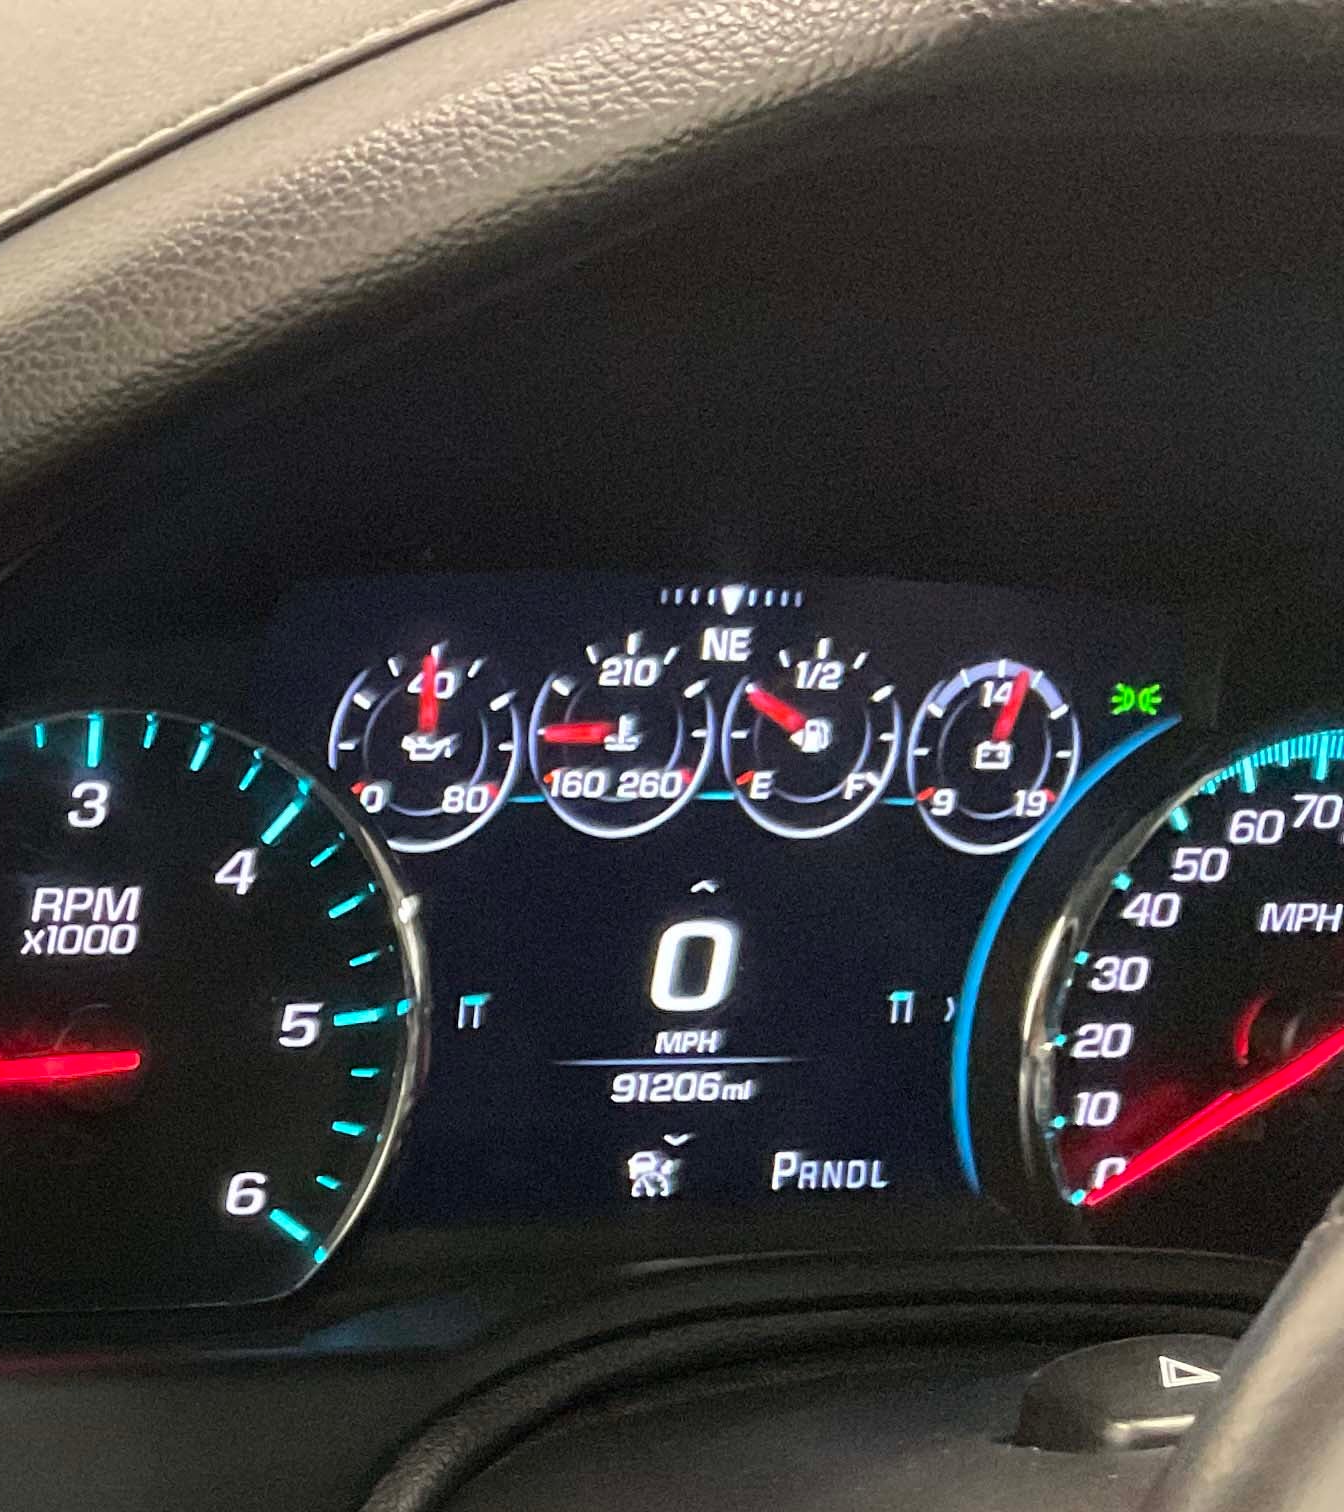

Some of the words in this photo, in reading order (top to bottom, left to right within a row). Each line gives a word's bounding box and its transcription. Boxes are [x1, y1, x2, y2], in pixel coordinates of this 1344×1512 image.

[701, 627, 752, 661] NE
[598, 657, 659, 687] 210
[795, 660, 844, 690] 1/2
[360, 783, 388, 814] 0
[441, 786, 489, 814] 80
[549, 768, 606, 800] 160
[616, 769, 683, 799] 260
[749, 771, 774, 799] E
[843, 772, 867, 799] F
[67, 780, 109, 828] 3
[931, 787, 957, 817] 9
[1013, 788, 1048, 817] 19
[1293, 794, 1343, 829] 70
[1228, 810, 1285, 844] 60
[214, 849, 256, 895] 4
[1171, 847, 1229, 882] 50
[31, 887, 141, 922] RPM
[1121, 892, 1181, 928] 40
[1259, 903, 1344, 932] MPH
[20, 923, 139, 955] x1000
[650, 919, 739, 1012] 0
[1090, 955, 1150, 991] 30
[279, 1003, 323, 1048] 5
[655, 1030, 722, 1054] MPH
[1070, 1023, 1132, 1058] 20
[1075, 1091, 1120, 1127] 10
[225, 1172, 267, 1216] 6
